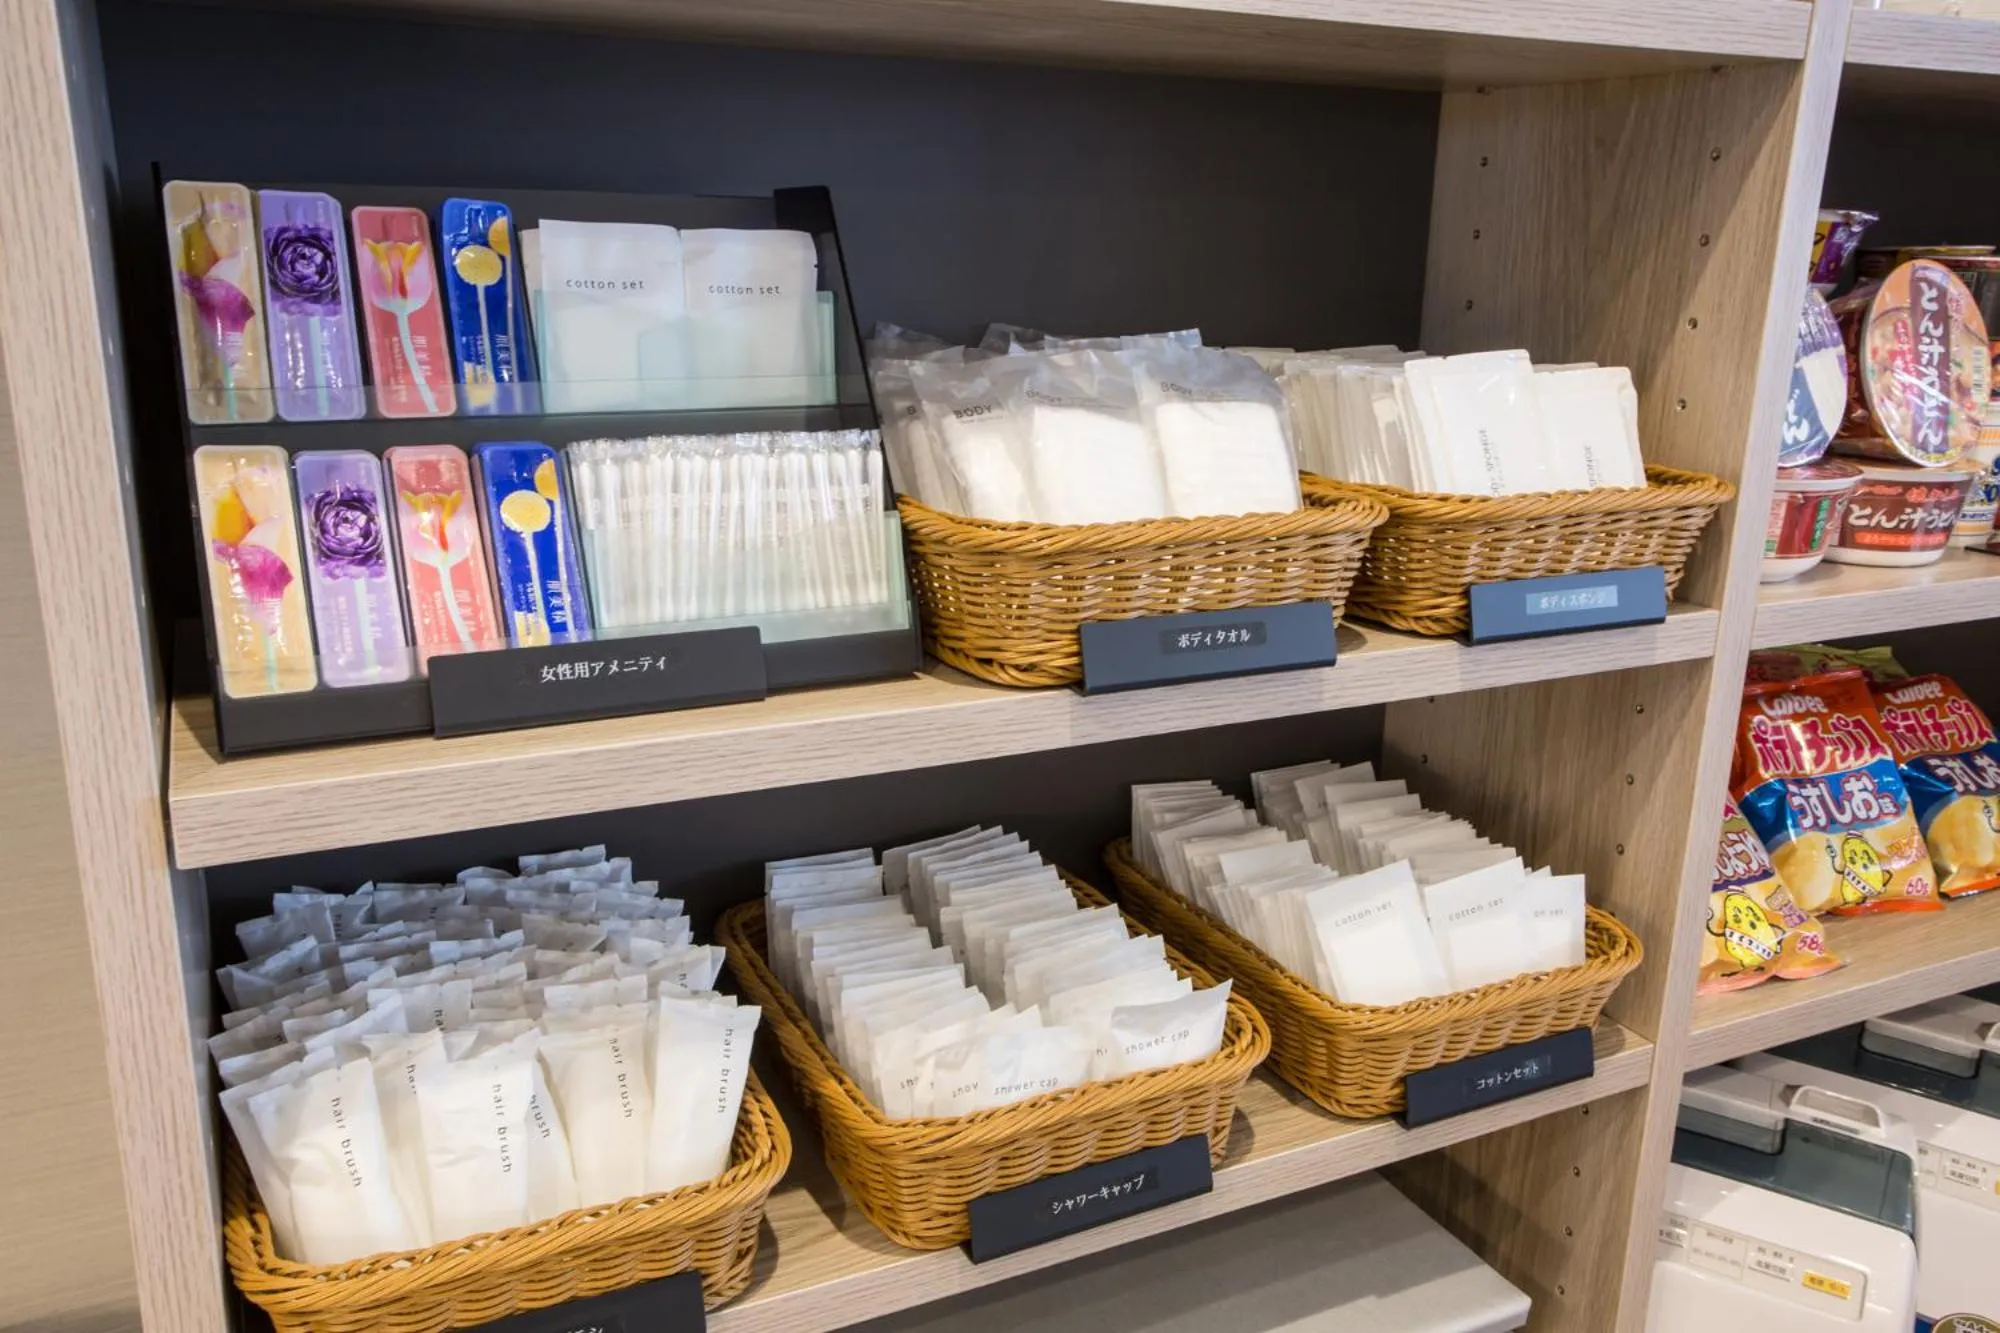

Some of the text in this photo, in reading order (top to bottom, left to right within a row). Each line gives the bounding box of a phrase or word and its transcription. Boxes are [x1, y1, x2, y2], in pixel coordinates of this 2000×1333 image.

[566, 278, 646, 291] cotton set
[708, 284, 781, 295] cotton set
[953, 404, 993, 419] BODY
[1178, 628, 1251, 648] ボディタオル
[540, 656, 667, 684] 女性用アメニティ
[1757, 693, 1829, 718] Calbee
[718, 1028, 734, 1113] hair brush
[1476, 1062, 1539, 1090] コットンセット
[618, 1073, 634, 1118] brush
[331, 1096, 363, 1187] hair brush
[492, 1083, 513, 1173] hair brush
[1052, 1174, 1145, 1215] シャワーキャップ
